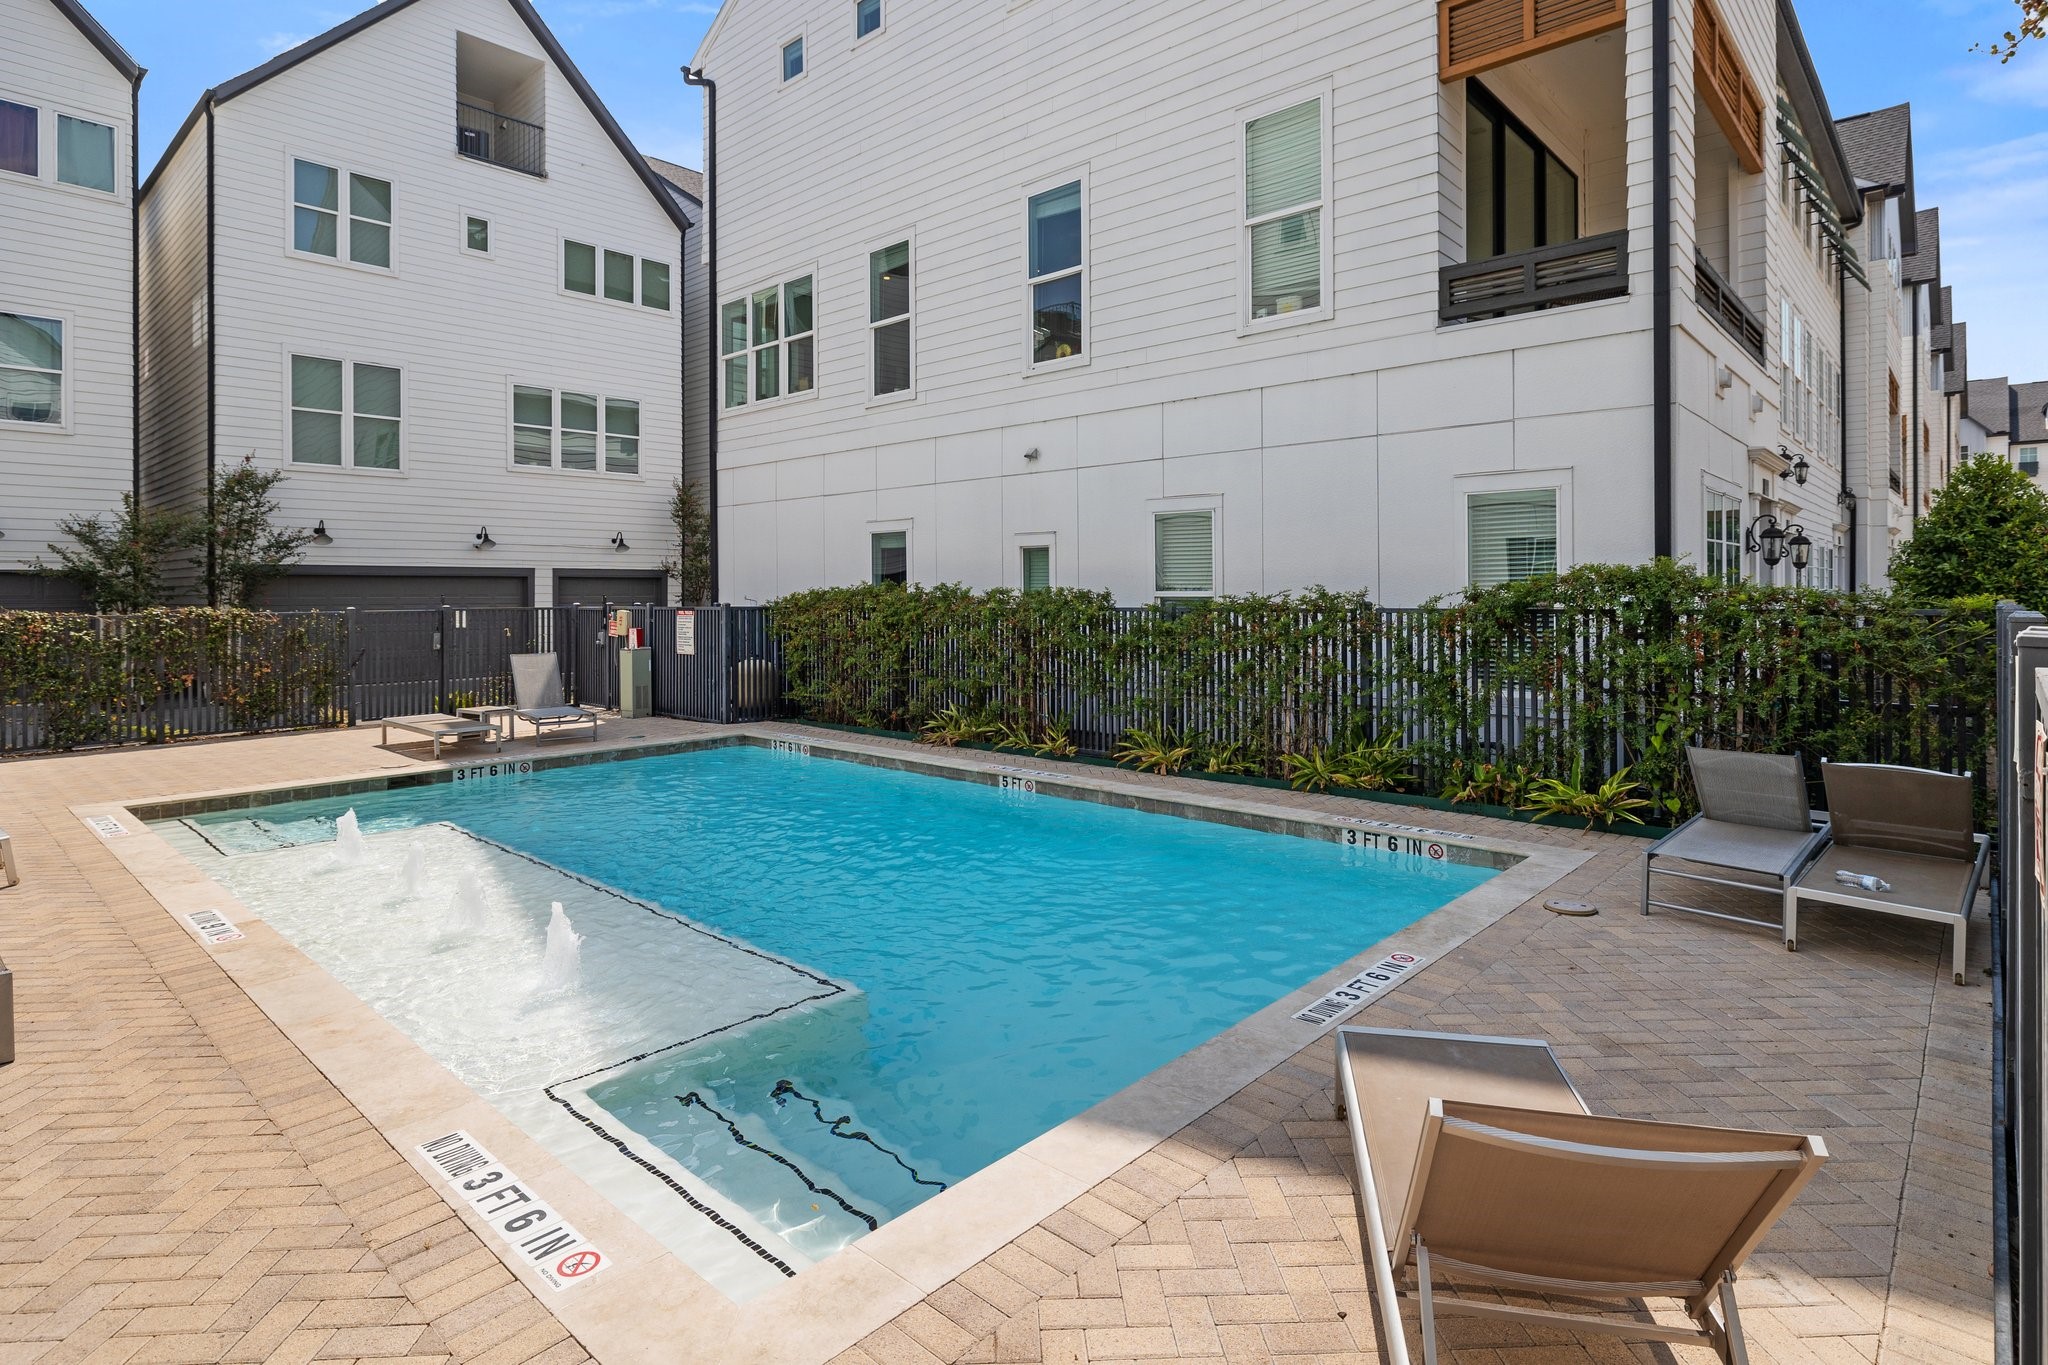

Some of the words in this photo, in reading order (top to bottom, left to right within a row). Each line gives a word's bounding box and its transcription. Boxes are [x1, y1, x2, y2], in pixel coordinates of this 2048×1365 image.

[772, 740, 778, 750] 3
[779, 741, 785, 751] FT
[788, 742, 793, 752] 6
[795, 743, 801, 753] IN
[458, 769, 465, 780] 3
[470, 766, 484, 779] FT
[490, 765, 497, 776] 6
[504, 762, 515, 775] IN
[1002, 776, 1008, 787] 5
[1011, 777, 1022, 790] FT
[1347, 830, 1357, 845] 3
[1363, 831, 1380, 849] FT
[1388, 836, 1398, 852] 6
[1406, 838, 1422, 857] IN
[1365, 972, 1391, 981] 6
[1376, 961, 1408, 974] IN
[1346, 979, 1379, 994] FT
[1335, 991, 1361, 1001] 3
[1307, 999, 1349, 1018] DIVING
[1296, 1013, 1326, 1025] NO
[421, 1132, 464, 1153] NO
[432, 1143, 489, 1177] DIVING
[463, 1171, 503, 1191] 3
[476, 1184, 531, 1214] FT
[504, 1209, 547, 1233] 6
[520, 1226, 577, 1261] IN
